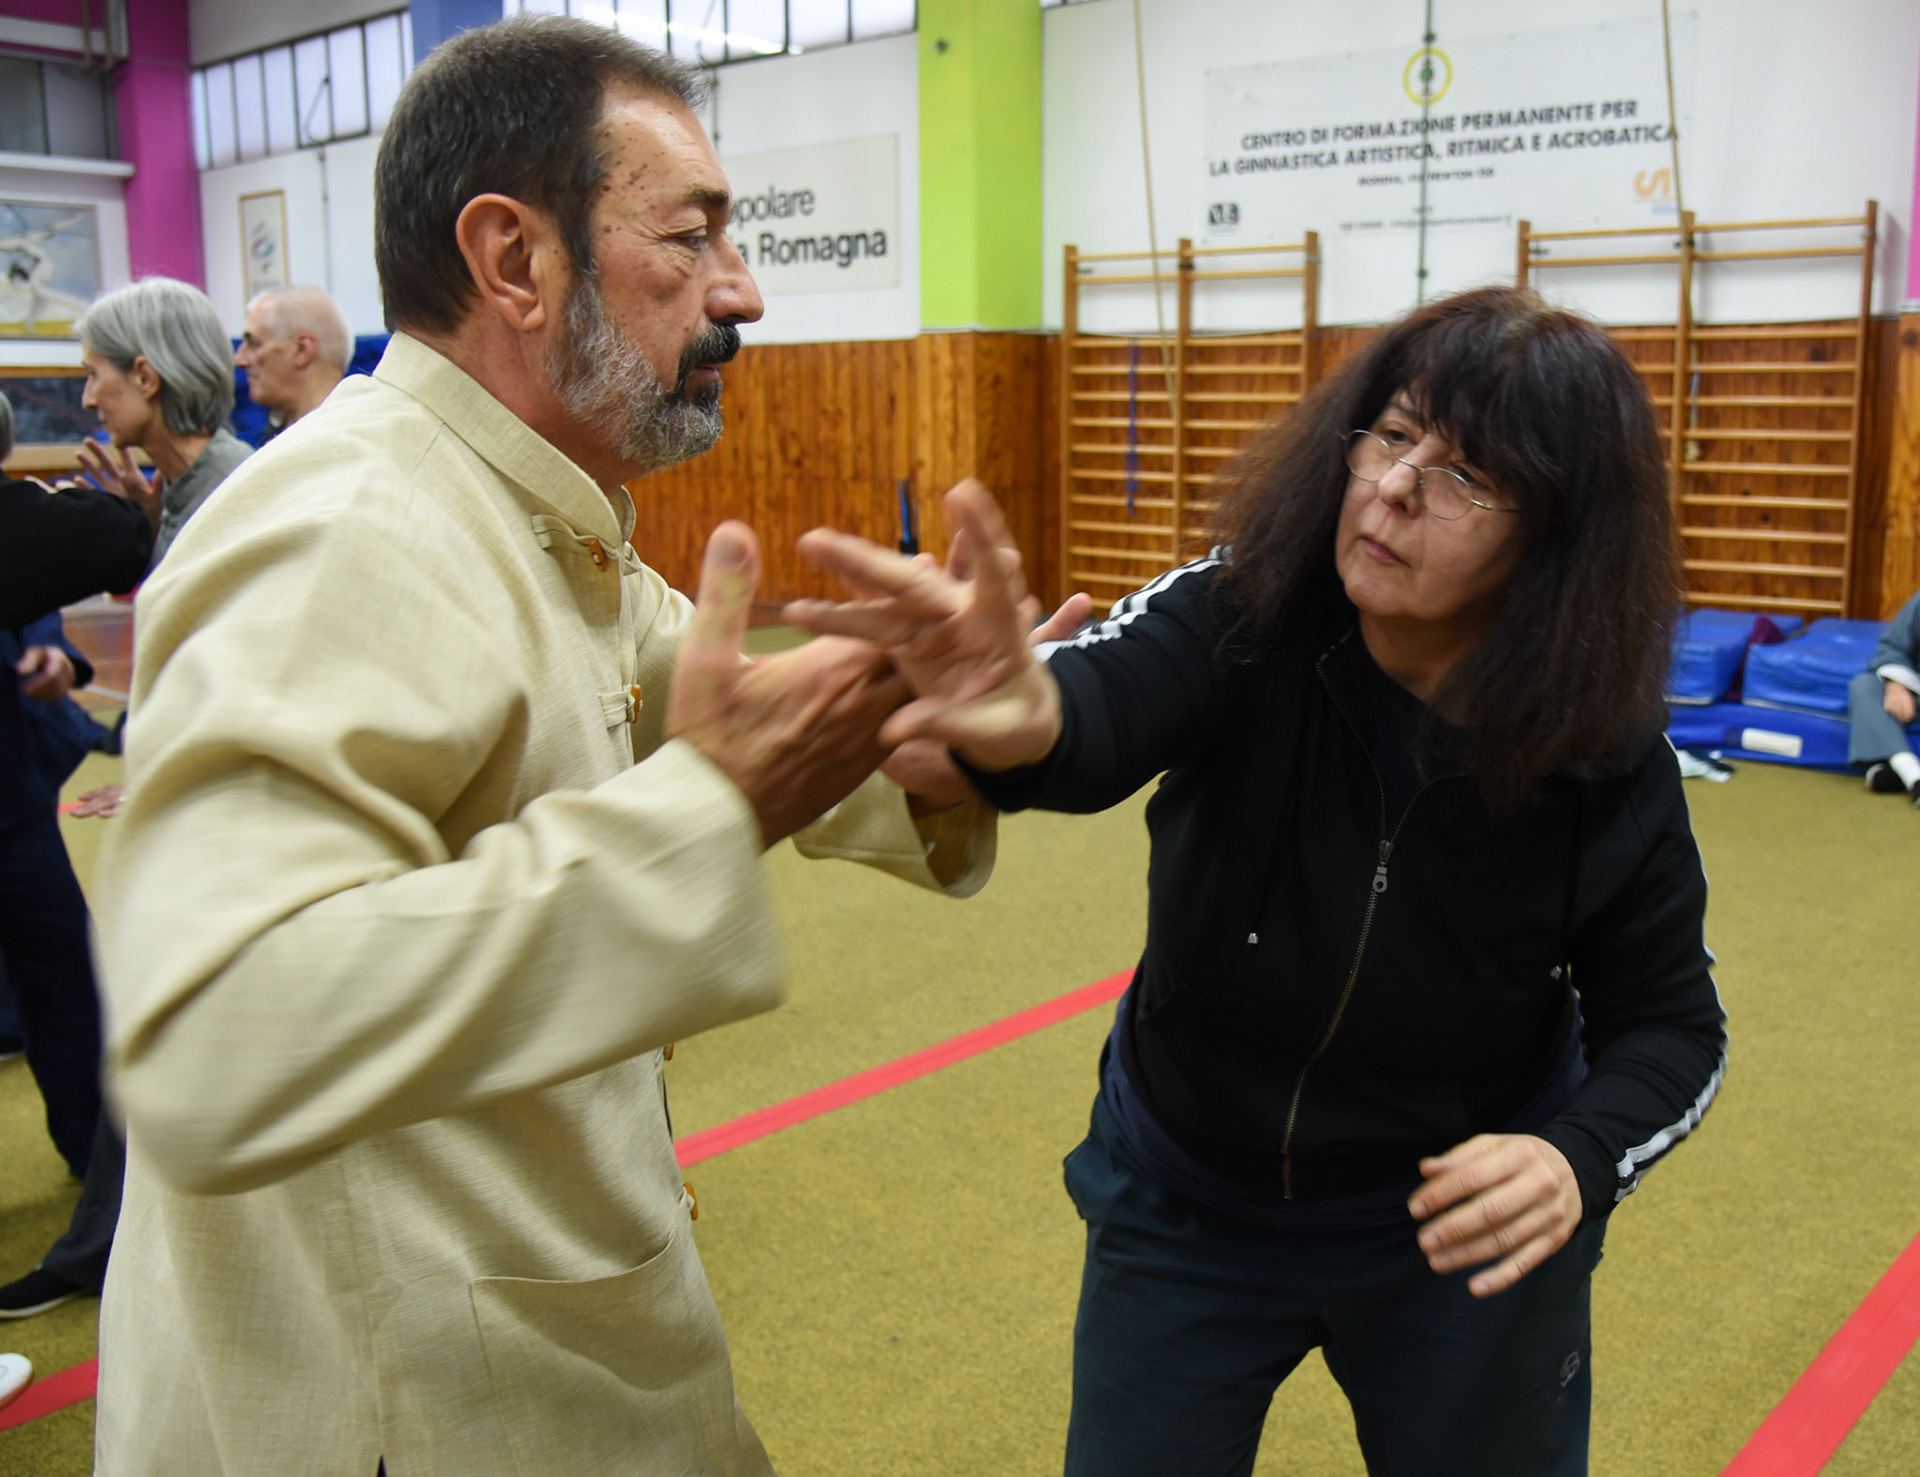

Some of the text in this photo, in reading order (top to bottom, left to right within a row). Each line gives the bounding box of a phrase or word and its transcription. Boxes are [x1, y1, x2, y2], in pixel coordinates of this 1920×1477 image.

[1209, 161, 1229, 177] LA
[1234, 151, 1338, 174] GINNASTICA
[1446, 134, 1525, 158] RITMICA
[1531, 133, 1541, 151] E
[1548, 124, 1678, 150] ACROBATICA
[1241, 99, 1638, 151] CENTRO DI FORMAZIONE PERMANENTE PER
[758, 229, 888, 268] Romagna
